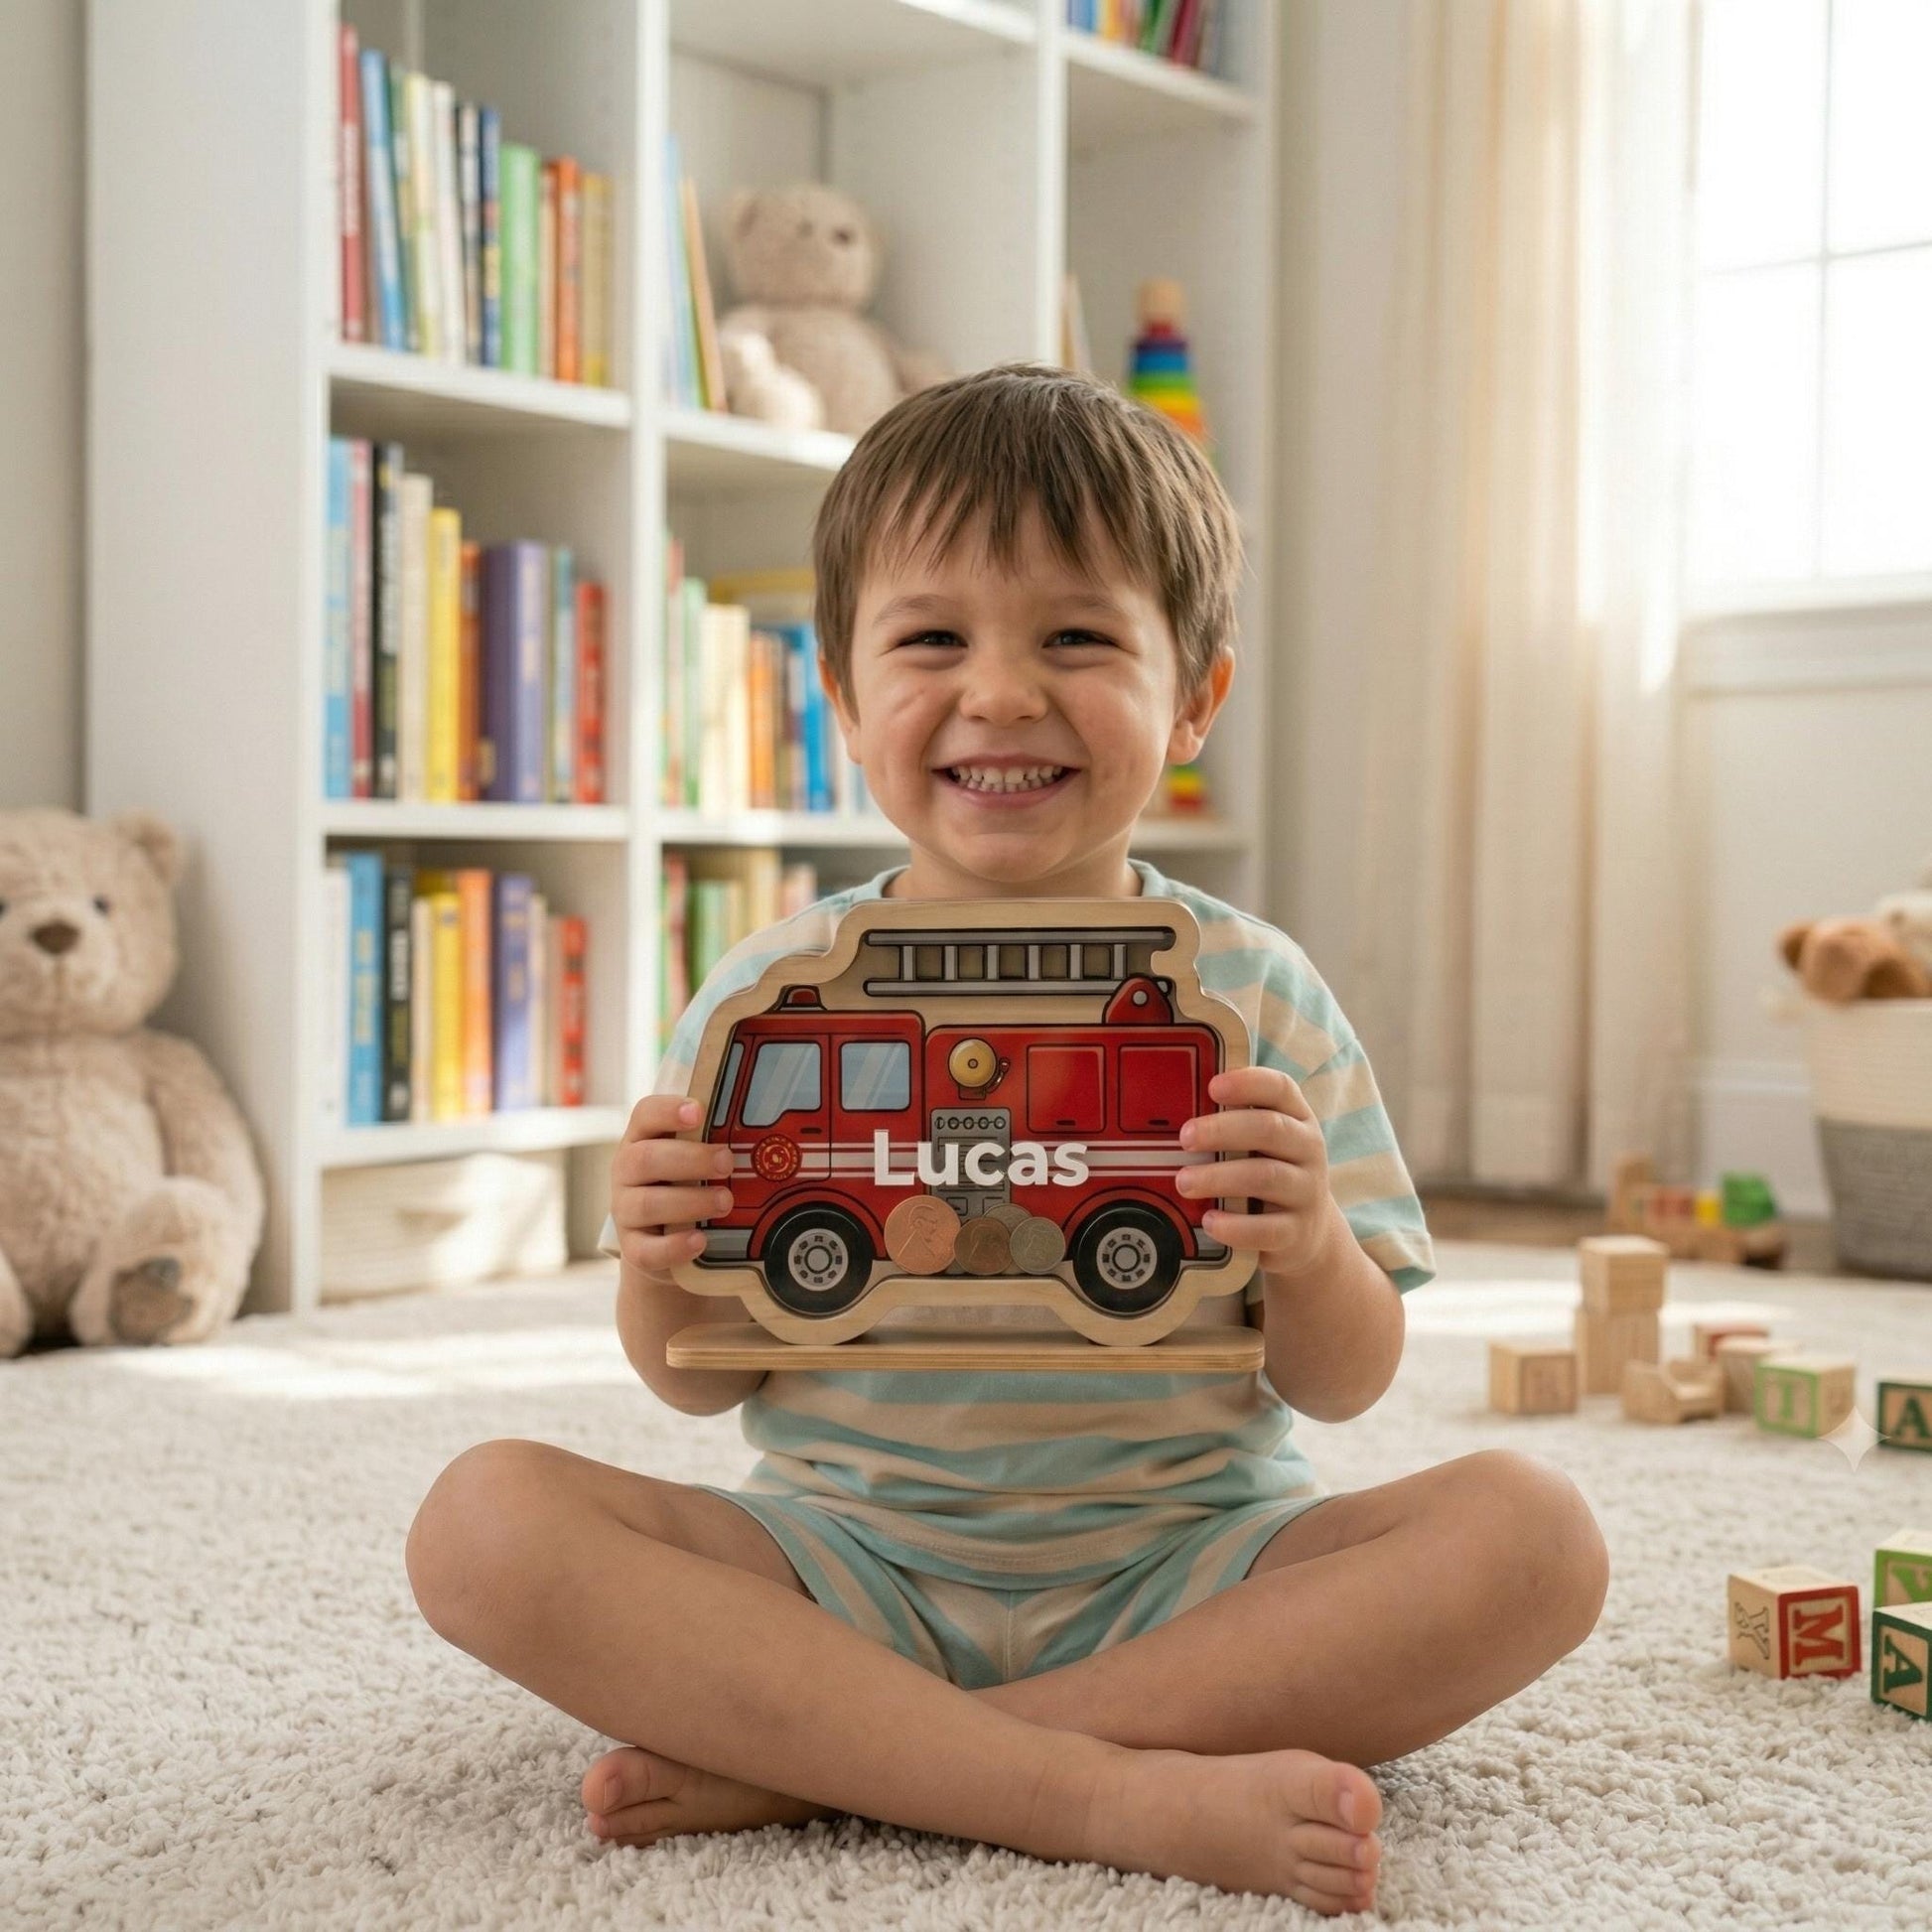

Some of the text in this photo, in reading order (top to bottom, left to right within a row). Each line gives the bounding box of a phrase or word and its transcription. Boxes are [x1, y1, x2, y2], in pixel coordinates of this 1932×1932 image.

[874, 1129, 1089, 1186] Lucas
[1892, 1395, 1932, 1440] A
[1793, 1604, 1845, 1667] M
[1882, 1634, 1924, 1695] A
